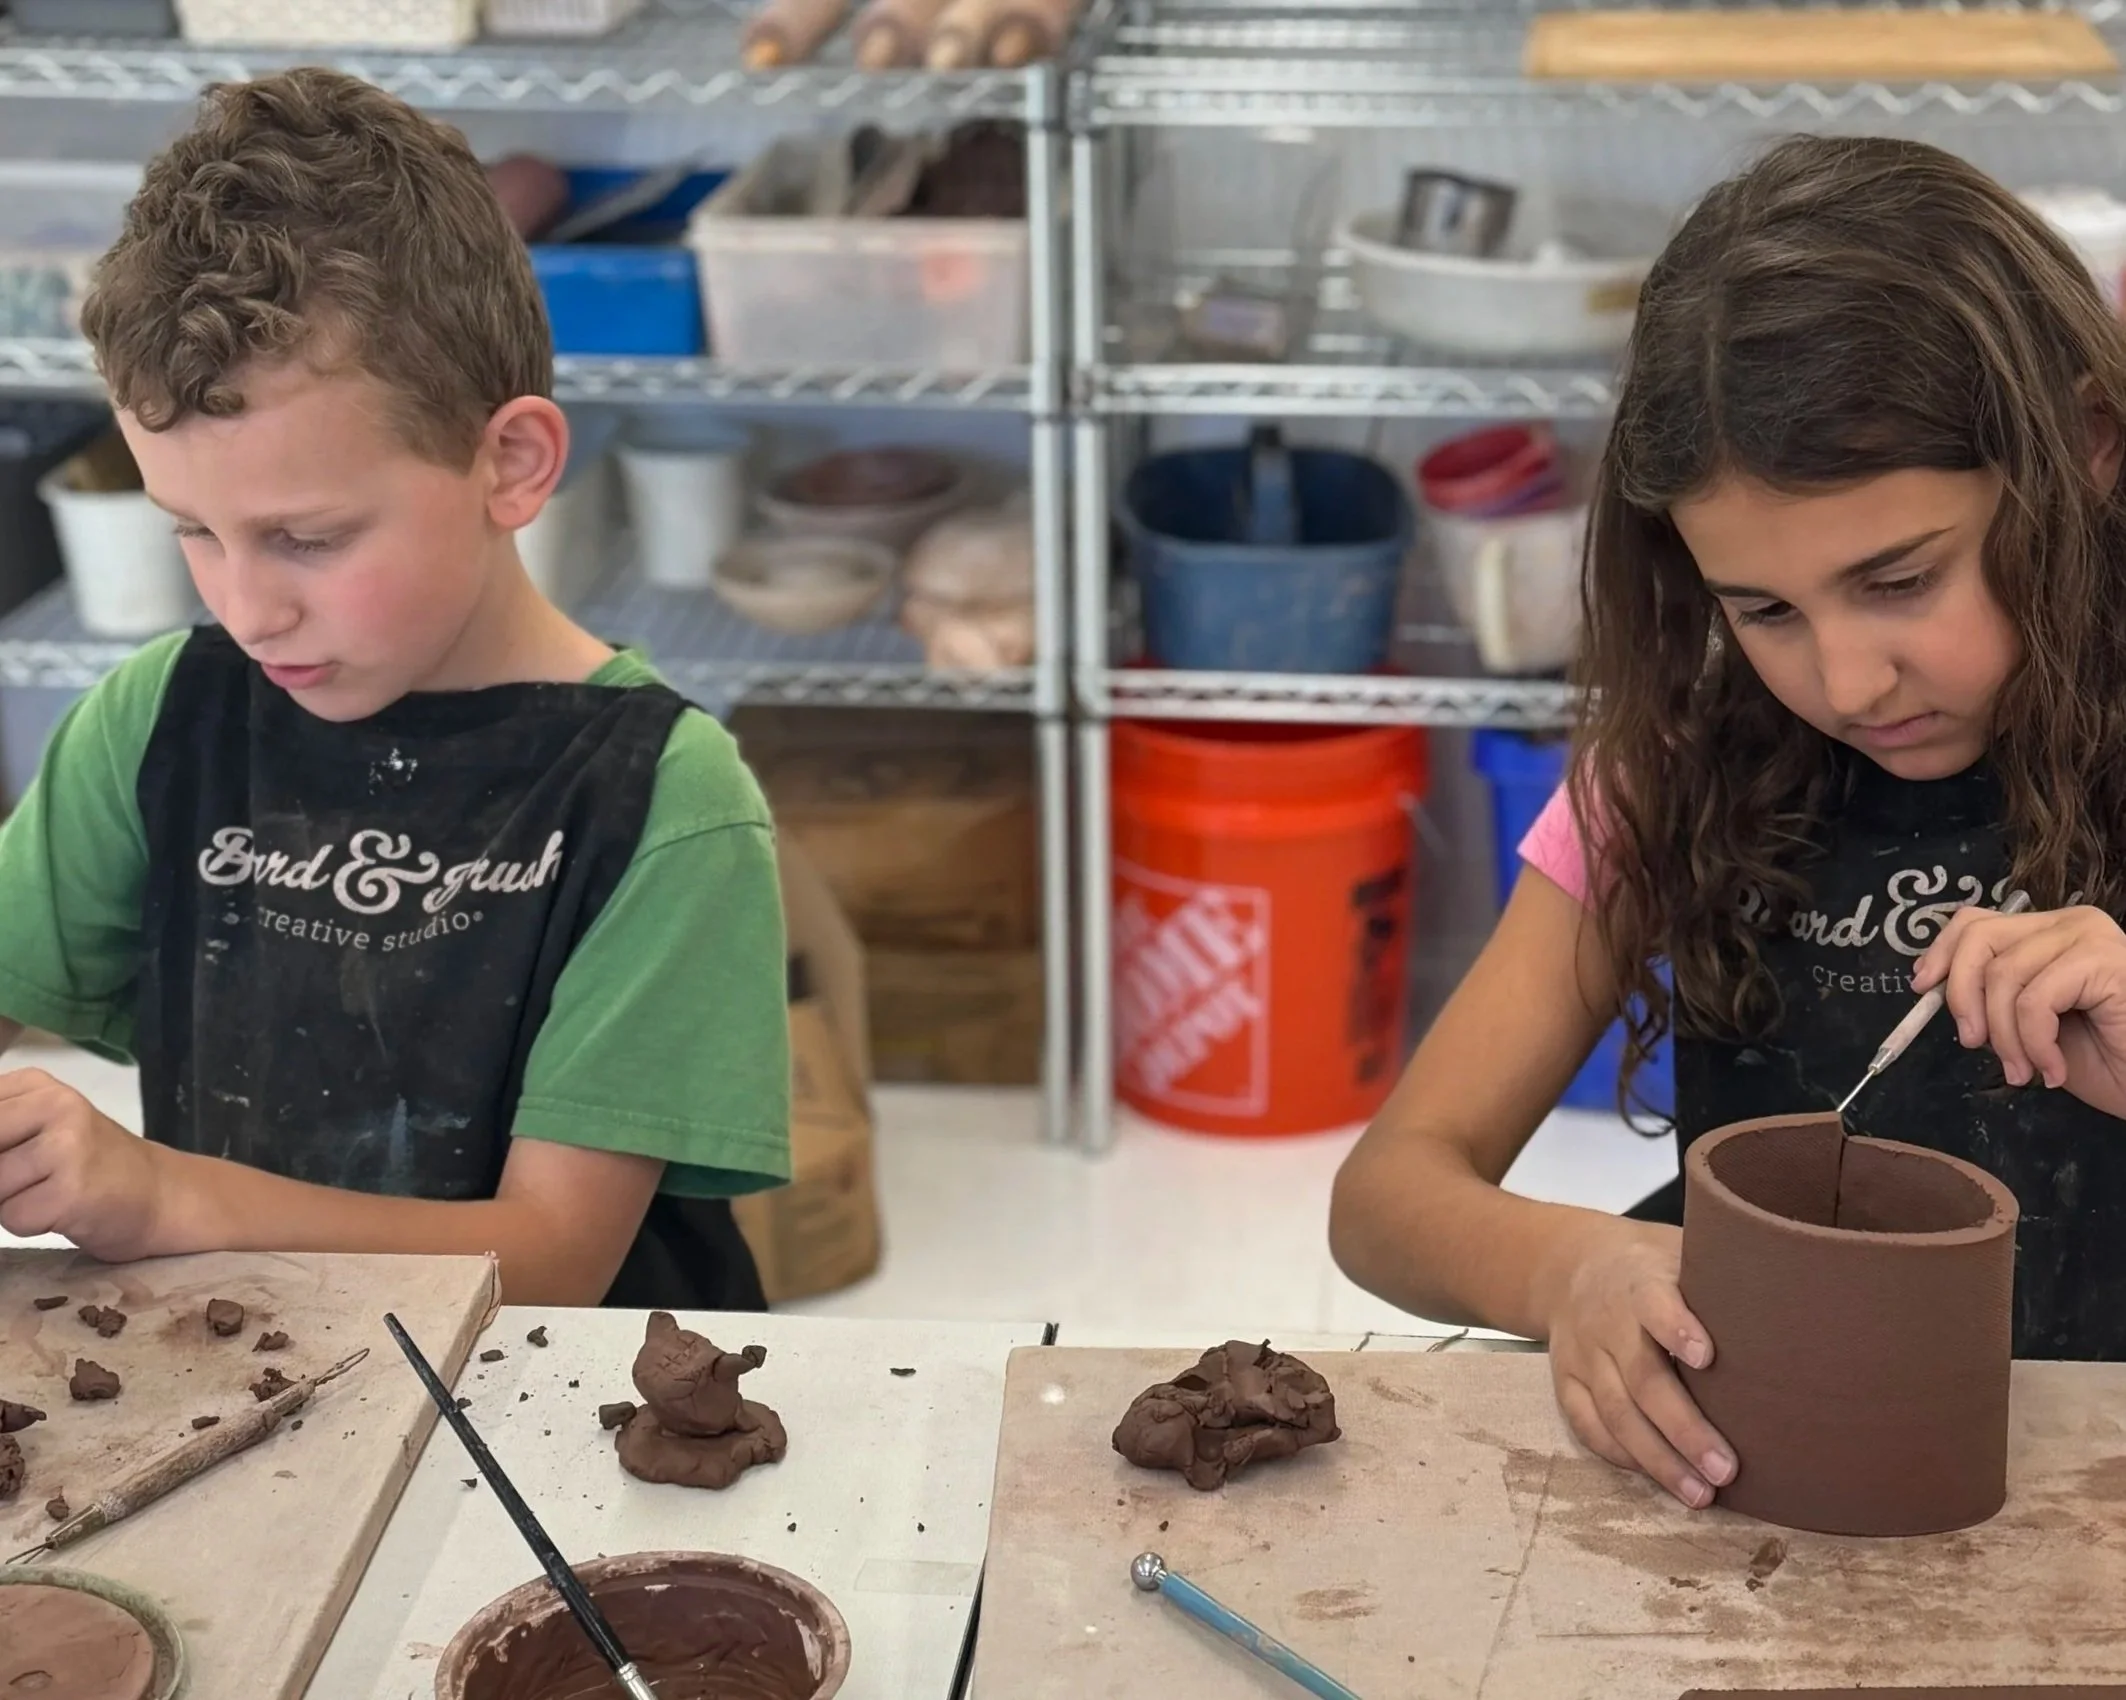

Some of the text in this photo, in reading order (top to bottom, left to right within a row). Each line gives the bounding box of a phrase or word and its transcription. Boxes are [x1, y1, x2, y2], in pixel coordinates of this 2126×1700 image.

[199, 826, 334, 890] Brd
[333, 829, 440, 914] &
[257, 906, 370, 950] reative
[1884, 865, 1983, 957] &
[1812, 964, 1915, 994] creati
